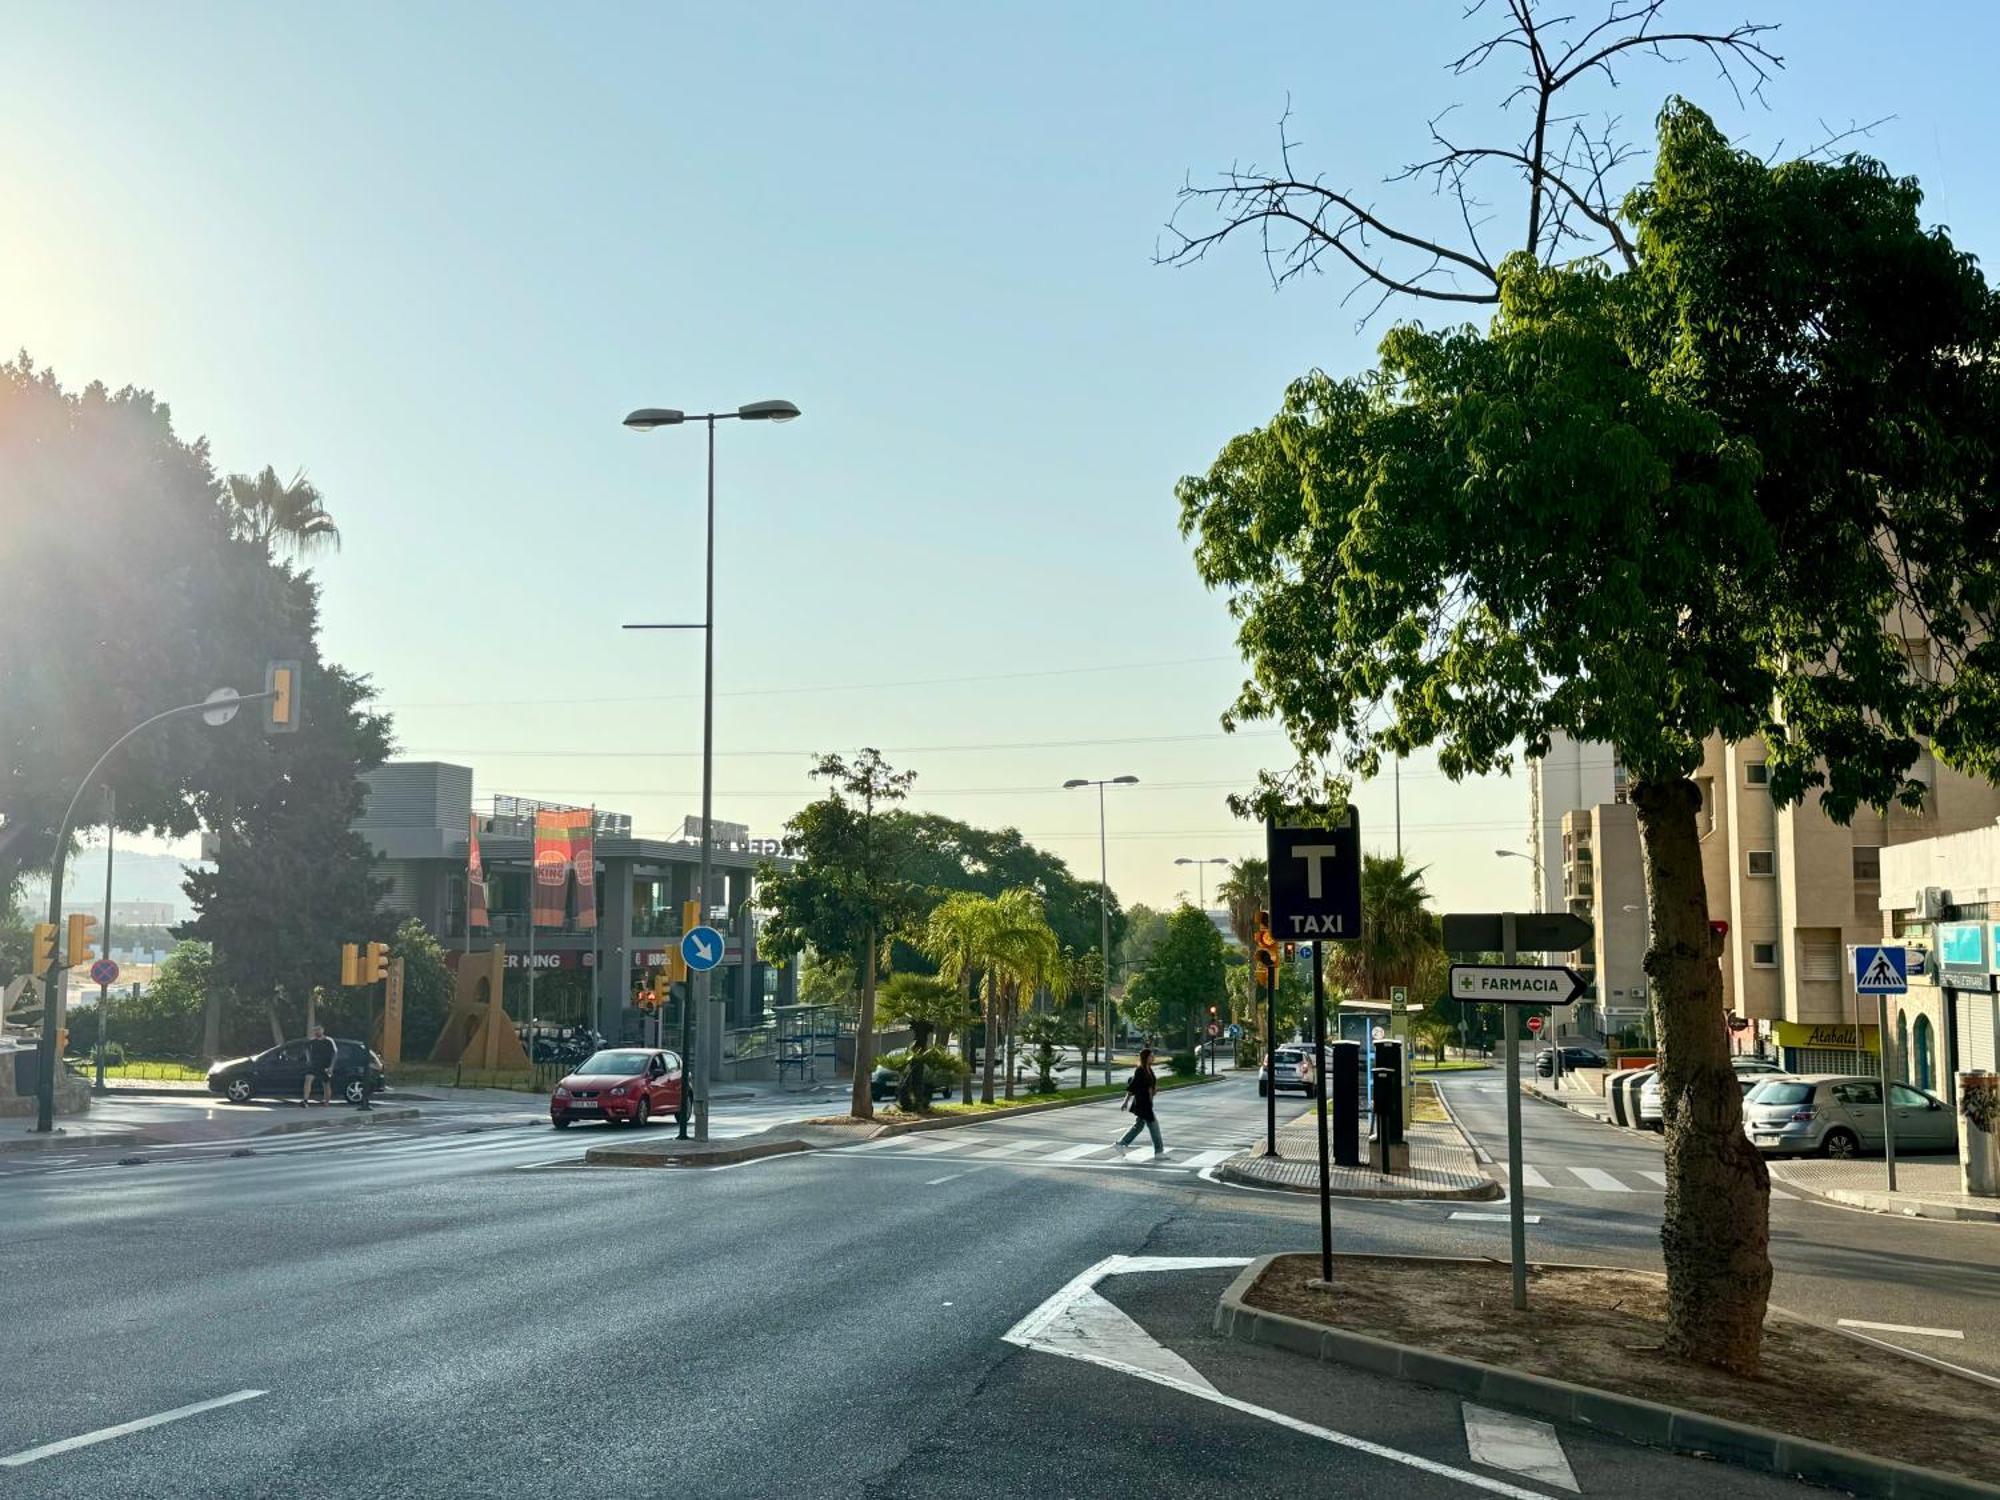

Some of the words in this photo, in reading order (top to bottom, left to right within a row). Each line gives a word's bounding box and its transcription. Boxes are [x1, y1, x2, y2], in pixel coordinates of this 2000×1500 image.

[538, 868, 564, 878] KING
[1291, 844, 1336, 899] T
[1289, 914, 1344, 933] TAXI
[522, 954, 561, 968] KING
[1481, 977, 1559, 992] FARMACIA
